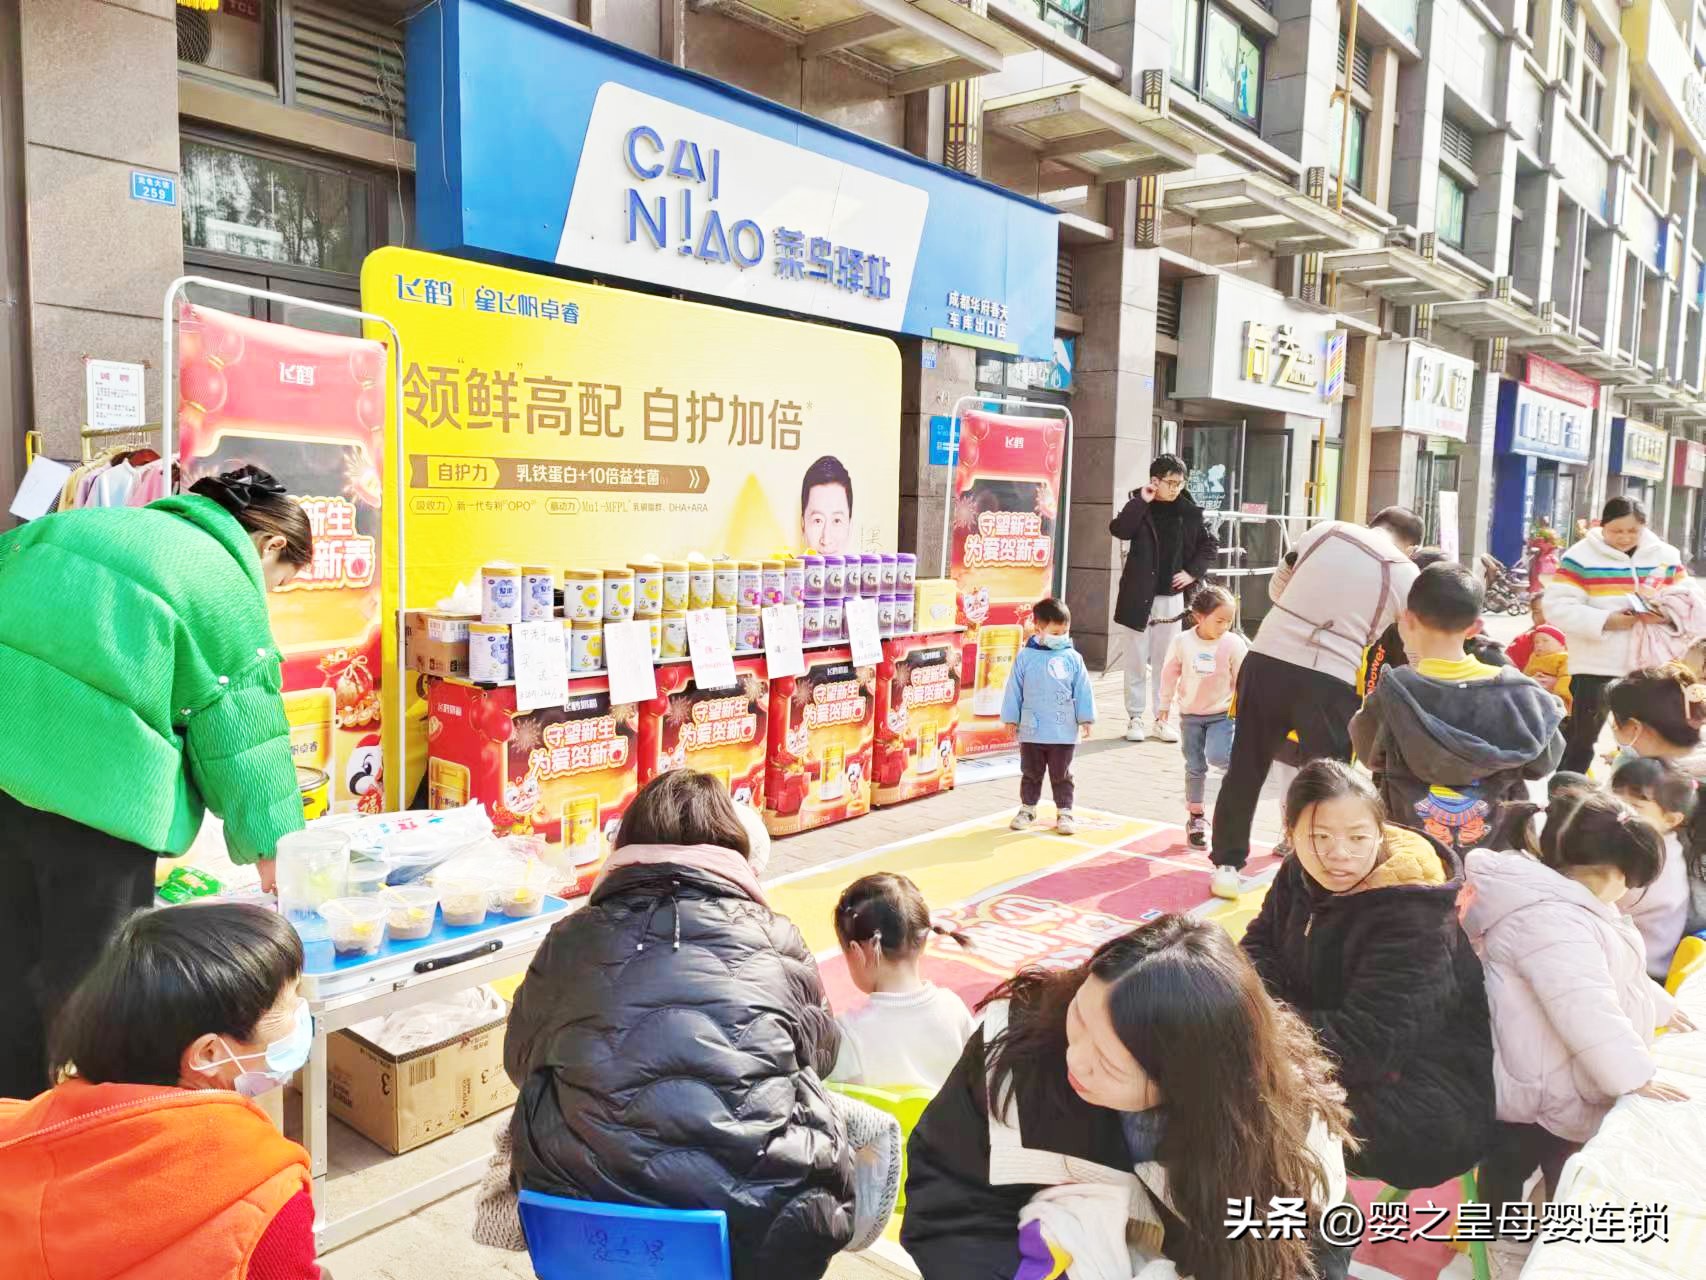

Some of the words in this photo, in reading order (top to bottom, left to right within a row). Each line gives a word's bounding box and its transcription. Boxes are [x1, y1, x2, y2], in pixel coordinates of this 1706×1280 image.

[623, 125, 720, 201] CAI
[143, 186, 166, 200] 259
[773, 226, 891, 300] 菜鸟驿站
[394, 274, 453, 306] 飞鹤
[475, 285, 579, 325] 星飞帆卓睿
[947, 290, 1008, 320] 成都华府春天
[947, 311, 1007, 338] 车库出口店
[279, 362, 316, 386] 飞鹤
[438, 463, 488, 481] 自护力
[981, 513, 1041, 536] 守望新生
[966, 537, 1049, 562] 为爱贺新春
[815, 683, 859, 702] 守望新生
[694, 700, 748, 722] 守望新生
[804, 698, 865, 725] 为爱贺新春
[546, 719, 616, 746] 守望新生
[681, 716, 755, 750] 为爱贺新春
[532, 738, 626, 777] 为爱贺新春
